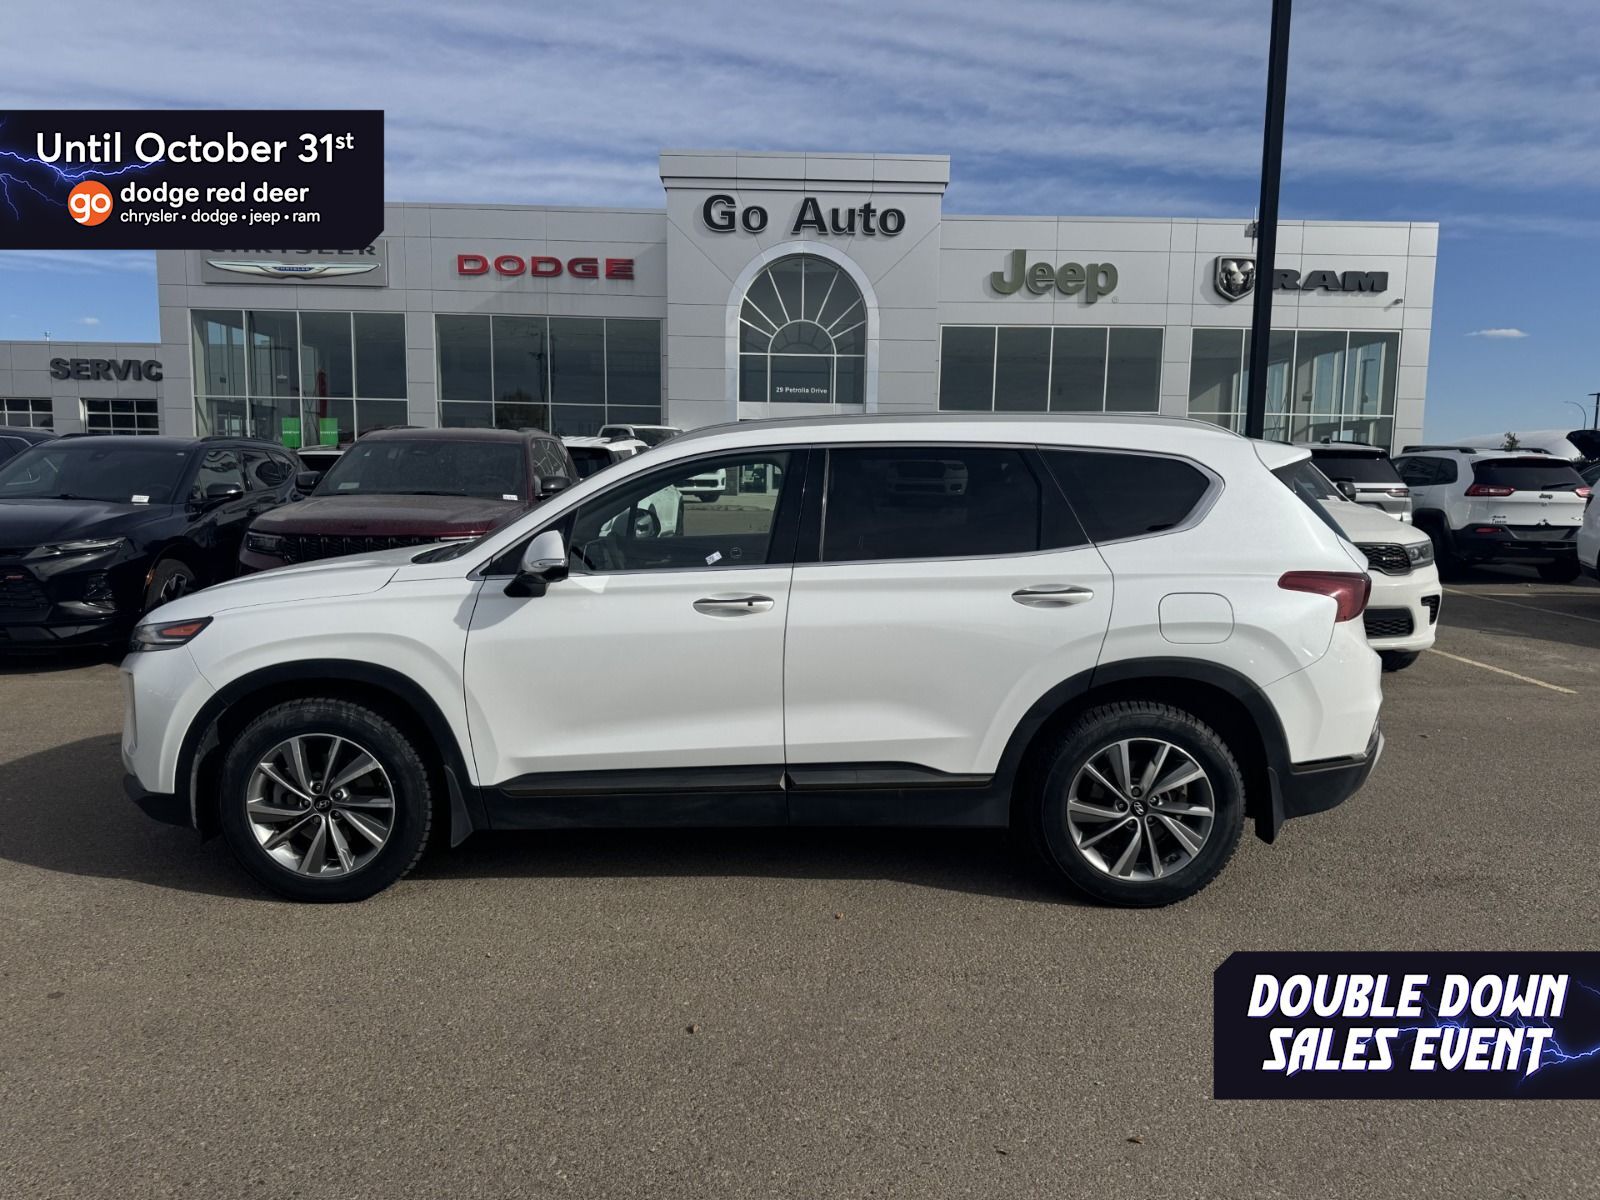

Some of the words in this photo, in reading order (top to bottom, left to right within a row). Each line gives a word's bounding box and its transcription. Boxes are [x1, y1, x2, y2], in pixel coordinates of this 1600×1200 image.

[703, 194, 769, 233] Go
[791, 197, 906, 236] Auto
[457, 254, 635, 280] DODGE
[990, 248, 1119, 304] Jeep
[1273, 269, 1389, 293] RAM
[49, 357, 163, 382] SERVIC
